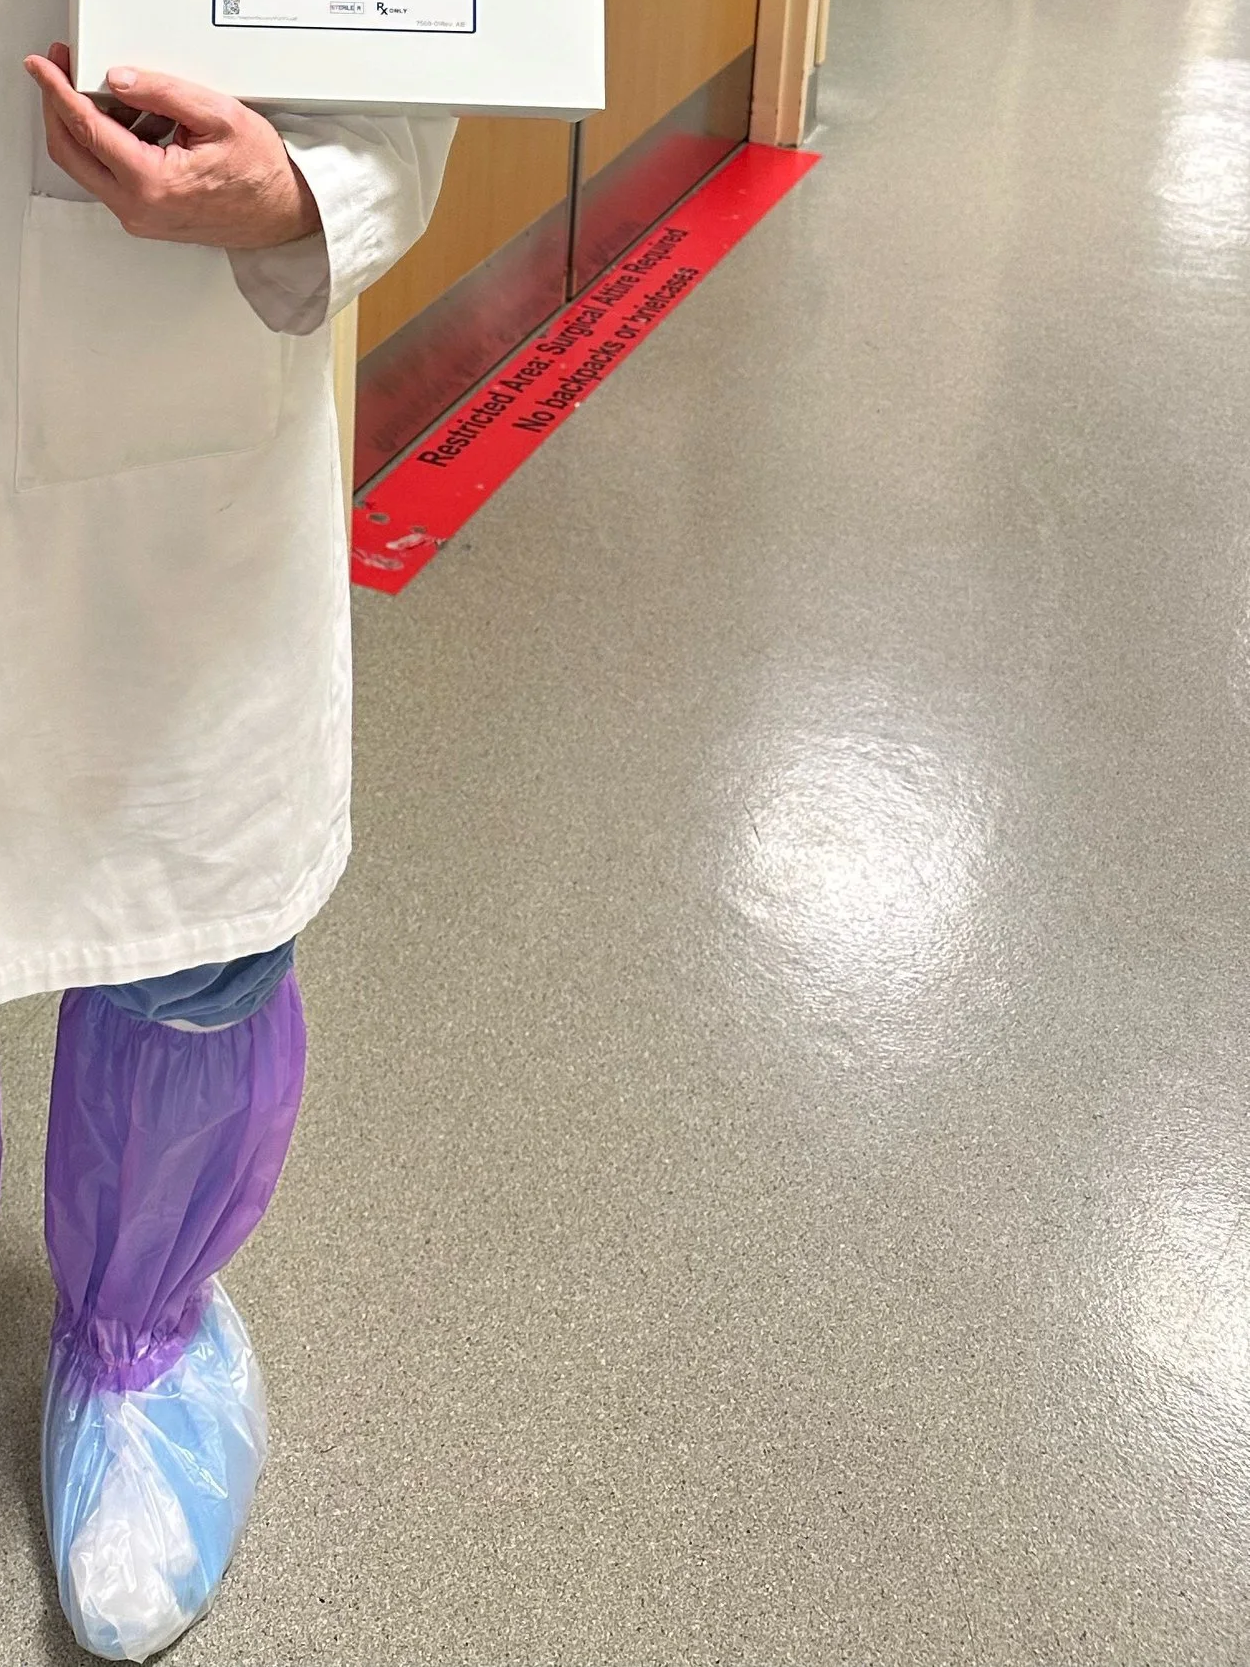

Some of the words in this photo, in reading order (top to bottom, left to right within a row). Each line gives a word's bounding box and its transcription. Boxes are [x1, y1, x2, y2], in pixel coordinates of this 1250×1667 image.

[622, 265, 700, 325] briefcases
[417, 388, 515, 468] Restricted
[500, 355, 556, 395] Area:
[535, 304, 607, 356] Surgical
[591, 273, 640, 309] Attire
[621, 227, 689, 275] Required
[614, 320, 641, 342] or
[547, 339, 627, 410] backpacks
[513, 399, 556, 435] No
